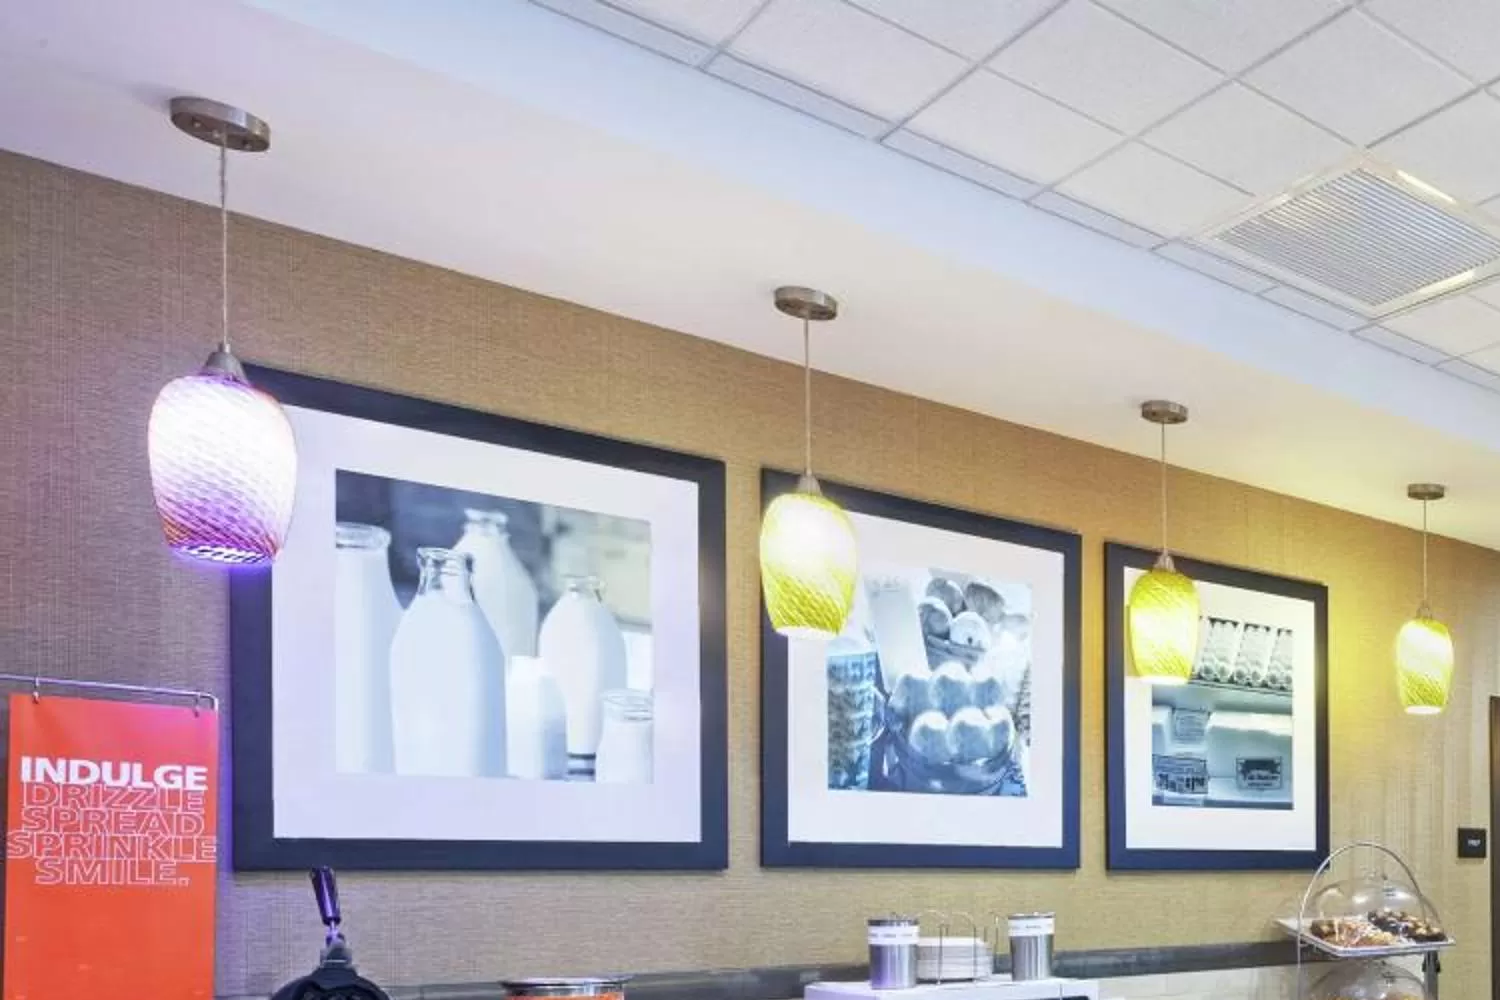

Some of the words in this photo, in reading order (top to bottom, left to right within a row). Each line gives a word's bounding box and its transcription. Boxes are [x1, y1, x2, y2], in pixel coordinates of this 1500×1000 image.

[20, 756, 208, 790] INDULGE
[22, 781, 206, 813] DRIZZLE
[21, 806, 205, 837] SPREAD
[6, 830, 217, 862] SPRINKLE
[35, 857, 190, 886] SMILE.
